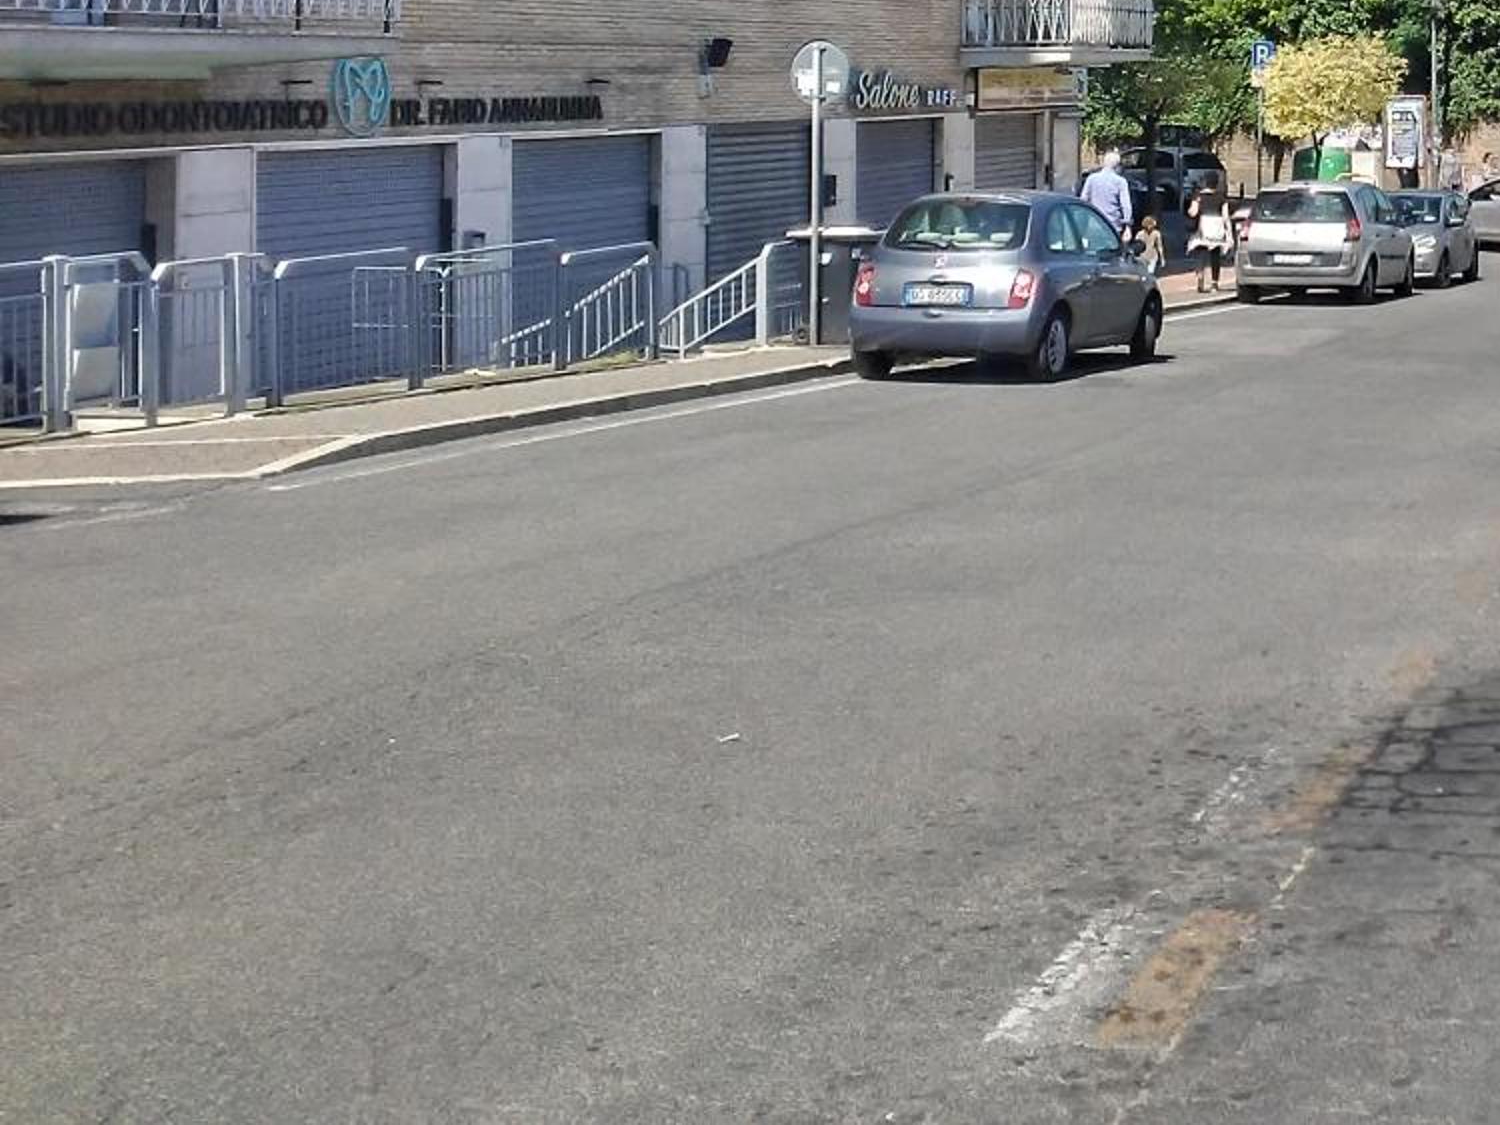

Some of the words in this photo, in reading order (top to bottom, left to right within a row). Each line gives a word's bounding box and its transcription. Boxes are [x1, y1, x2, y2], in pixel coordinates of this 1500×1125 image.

[856, 71, 920, 108] Salone
[0, 101, 112, 139] STUDIO
[118, 98, 328, 135] ODONTOIATRICO
